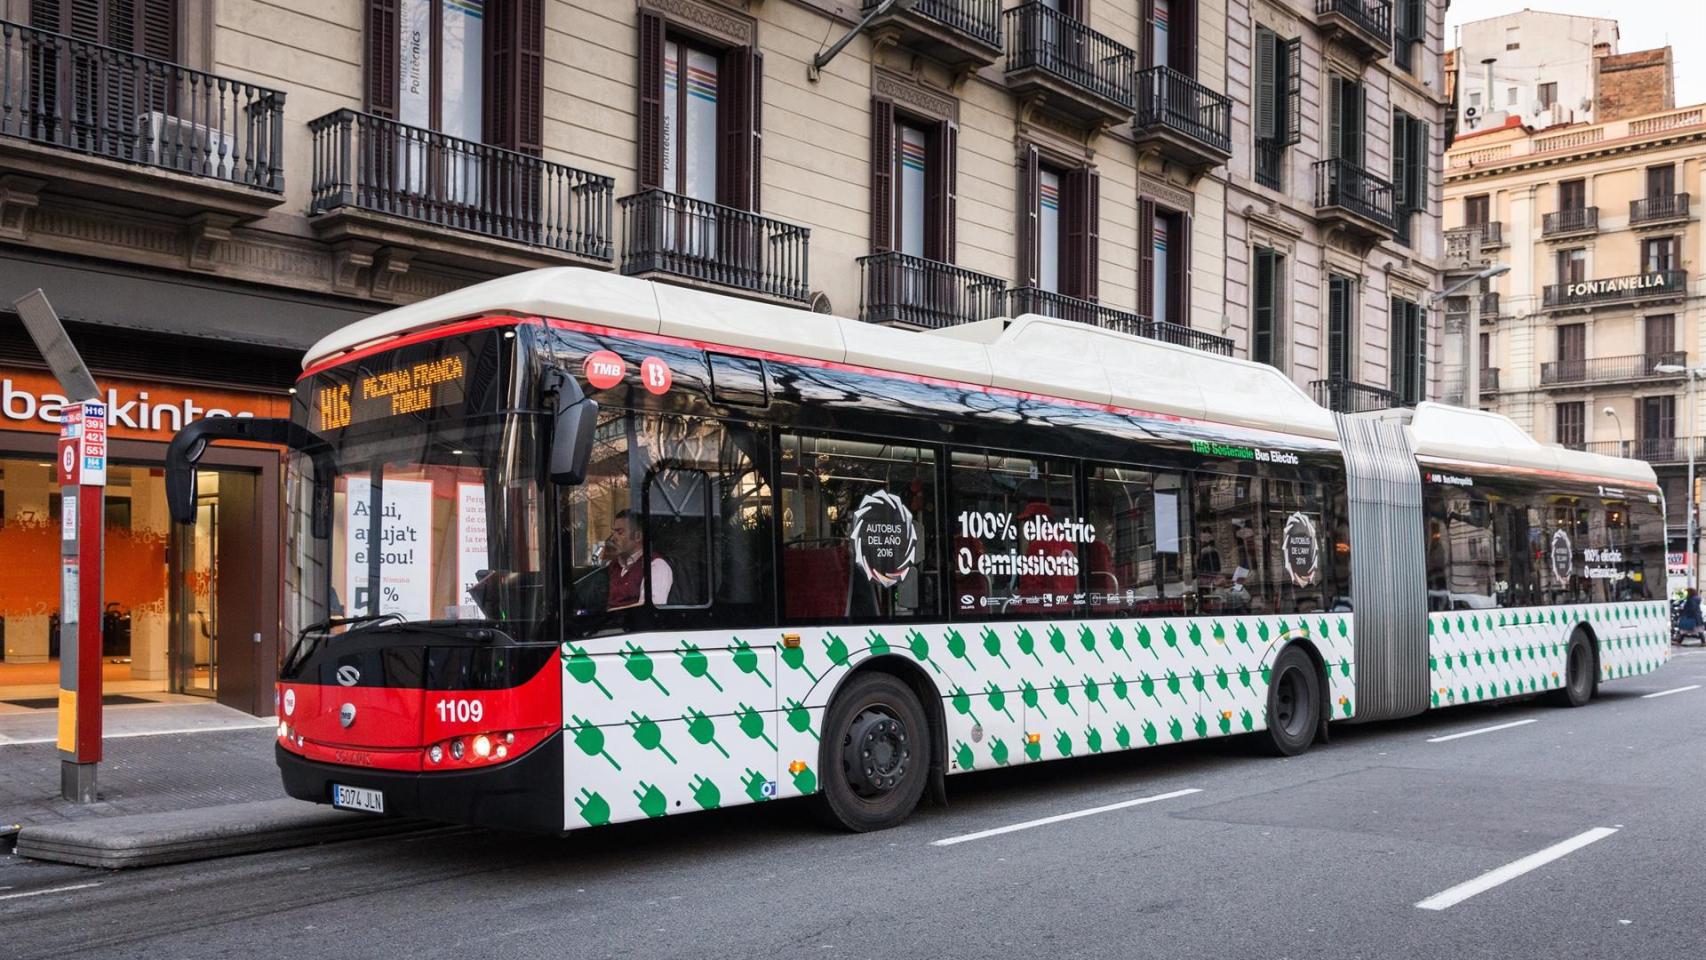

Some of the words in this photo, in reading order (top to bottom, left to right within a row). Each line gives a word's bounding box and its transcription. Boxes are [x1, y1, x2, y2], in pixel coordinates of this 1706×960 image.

[410, 30, 420, 95] Politècnics
[1567, 274, 1665, 297] FONTANELLA
[413, 355, 464, 388] FRANCA
[592, 362, 622, 377] TMB
[2, 379, 254, 431] bakint
[320, 383, 351, 431] H16
[391, 387, 432, 416] FORUM
[85, 406, 104, 416] H16
[86, 419, 99, 430] 39
[86, 432, 99, 442] 42
[86, 446, 99, 456] 55
[1254, 448, 1270, 461] Bus
[465, 496, 485, 505] Perq
[353, 501, 401, 520] Aui,
[465, 525, 486, 533] disse
[866, 523, 902, 533] AUTOBUS
[958, 511, 1018, 541] 100%
[1023, 514, 1096, 543] elèctric
[867, 535, 883, 545] DEL
[884, 534, 902, 546] AÑO
[380, 549, 414, 565] sou!
[877, 547, 894, 558] 2016
[957, 547, 973, 575] 0
[977, 548, 1080, 576] emissions
[436, 699, 484, 723] 1109
[340, 787, 362, 807] 5074
[364, 791, 382, 811] JLN
